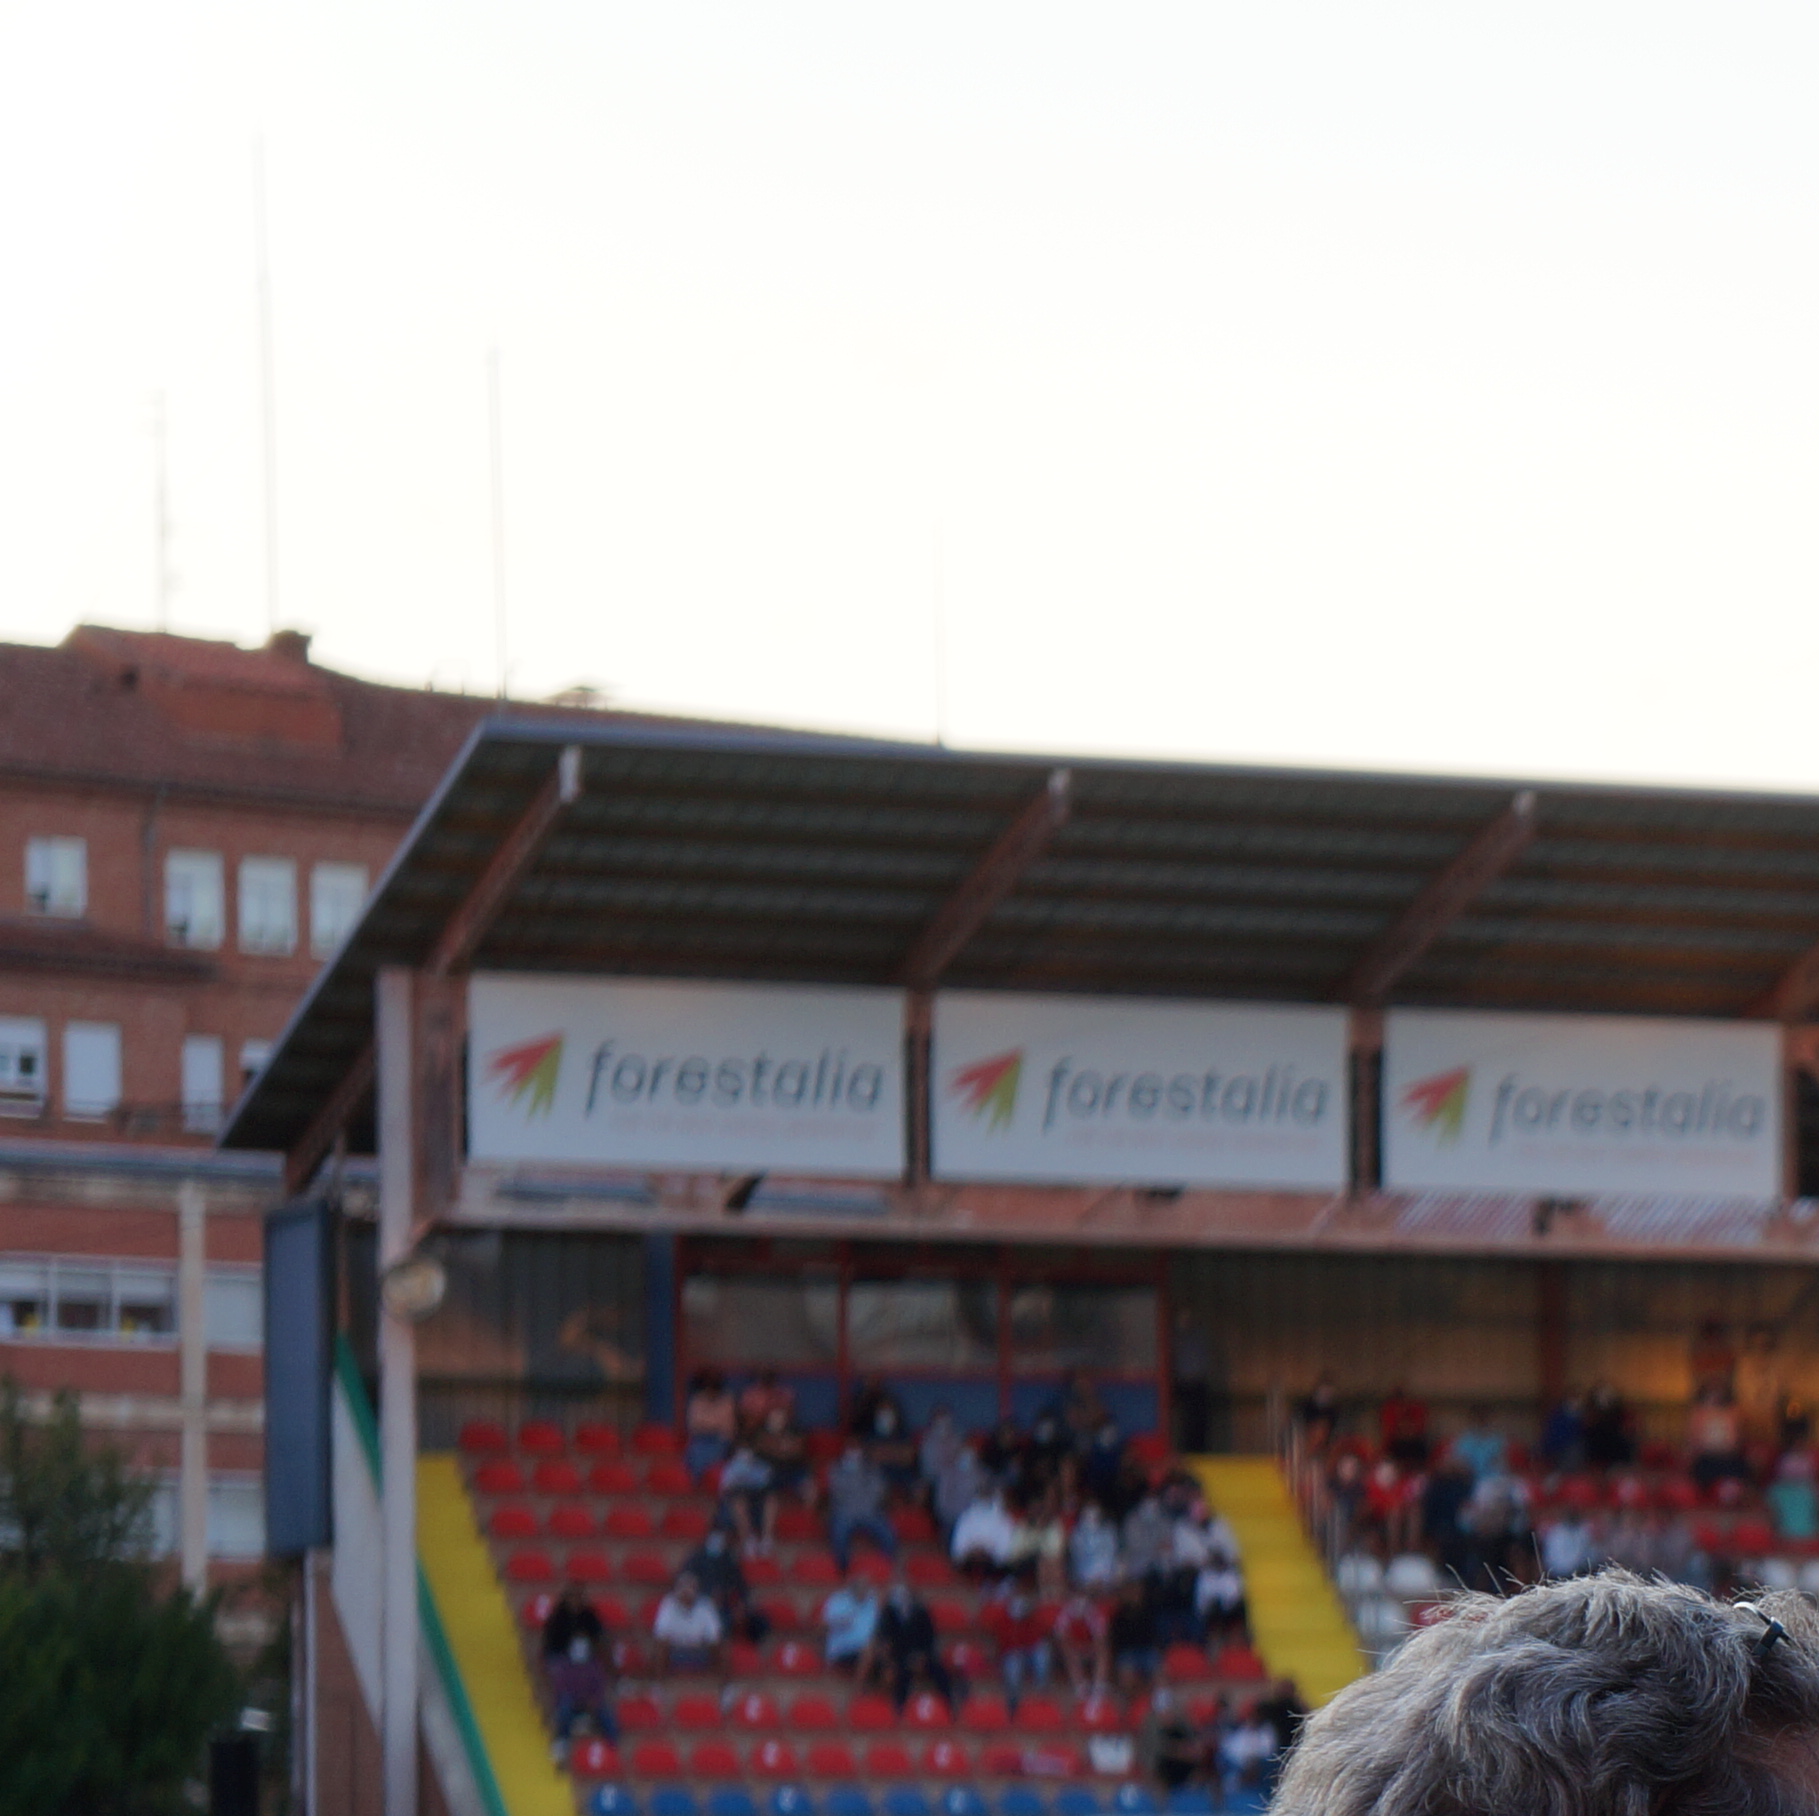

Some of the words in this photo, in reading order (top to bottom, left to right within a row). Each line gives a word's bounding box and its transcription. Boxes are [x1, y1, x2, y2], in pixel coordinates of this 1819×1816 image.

[583, 1038, 885, 1119] forestalia
[1042, 1055, 1331, 1135] forestalia
[1489, 1072, 1767, 1148] forestalia
